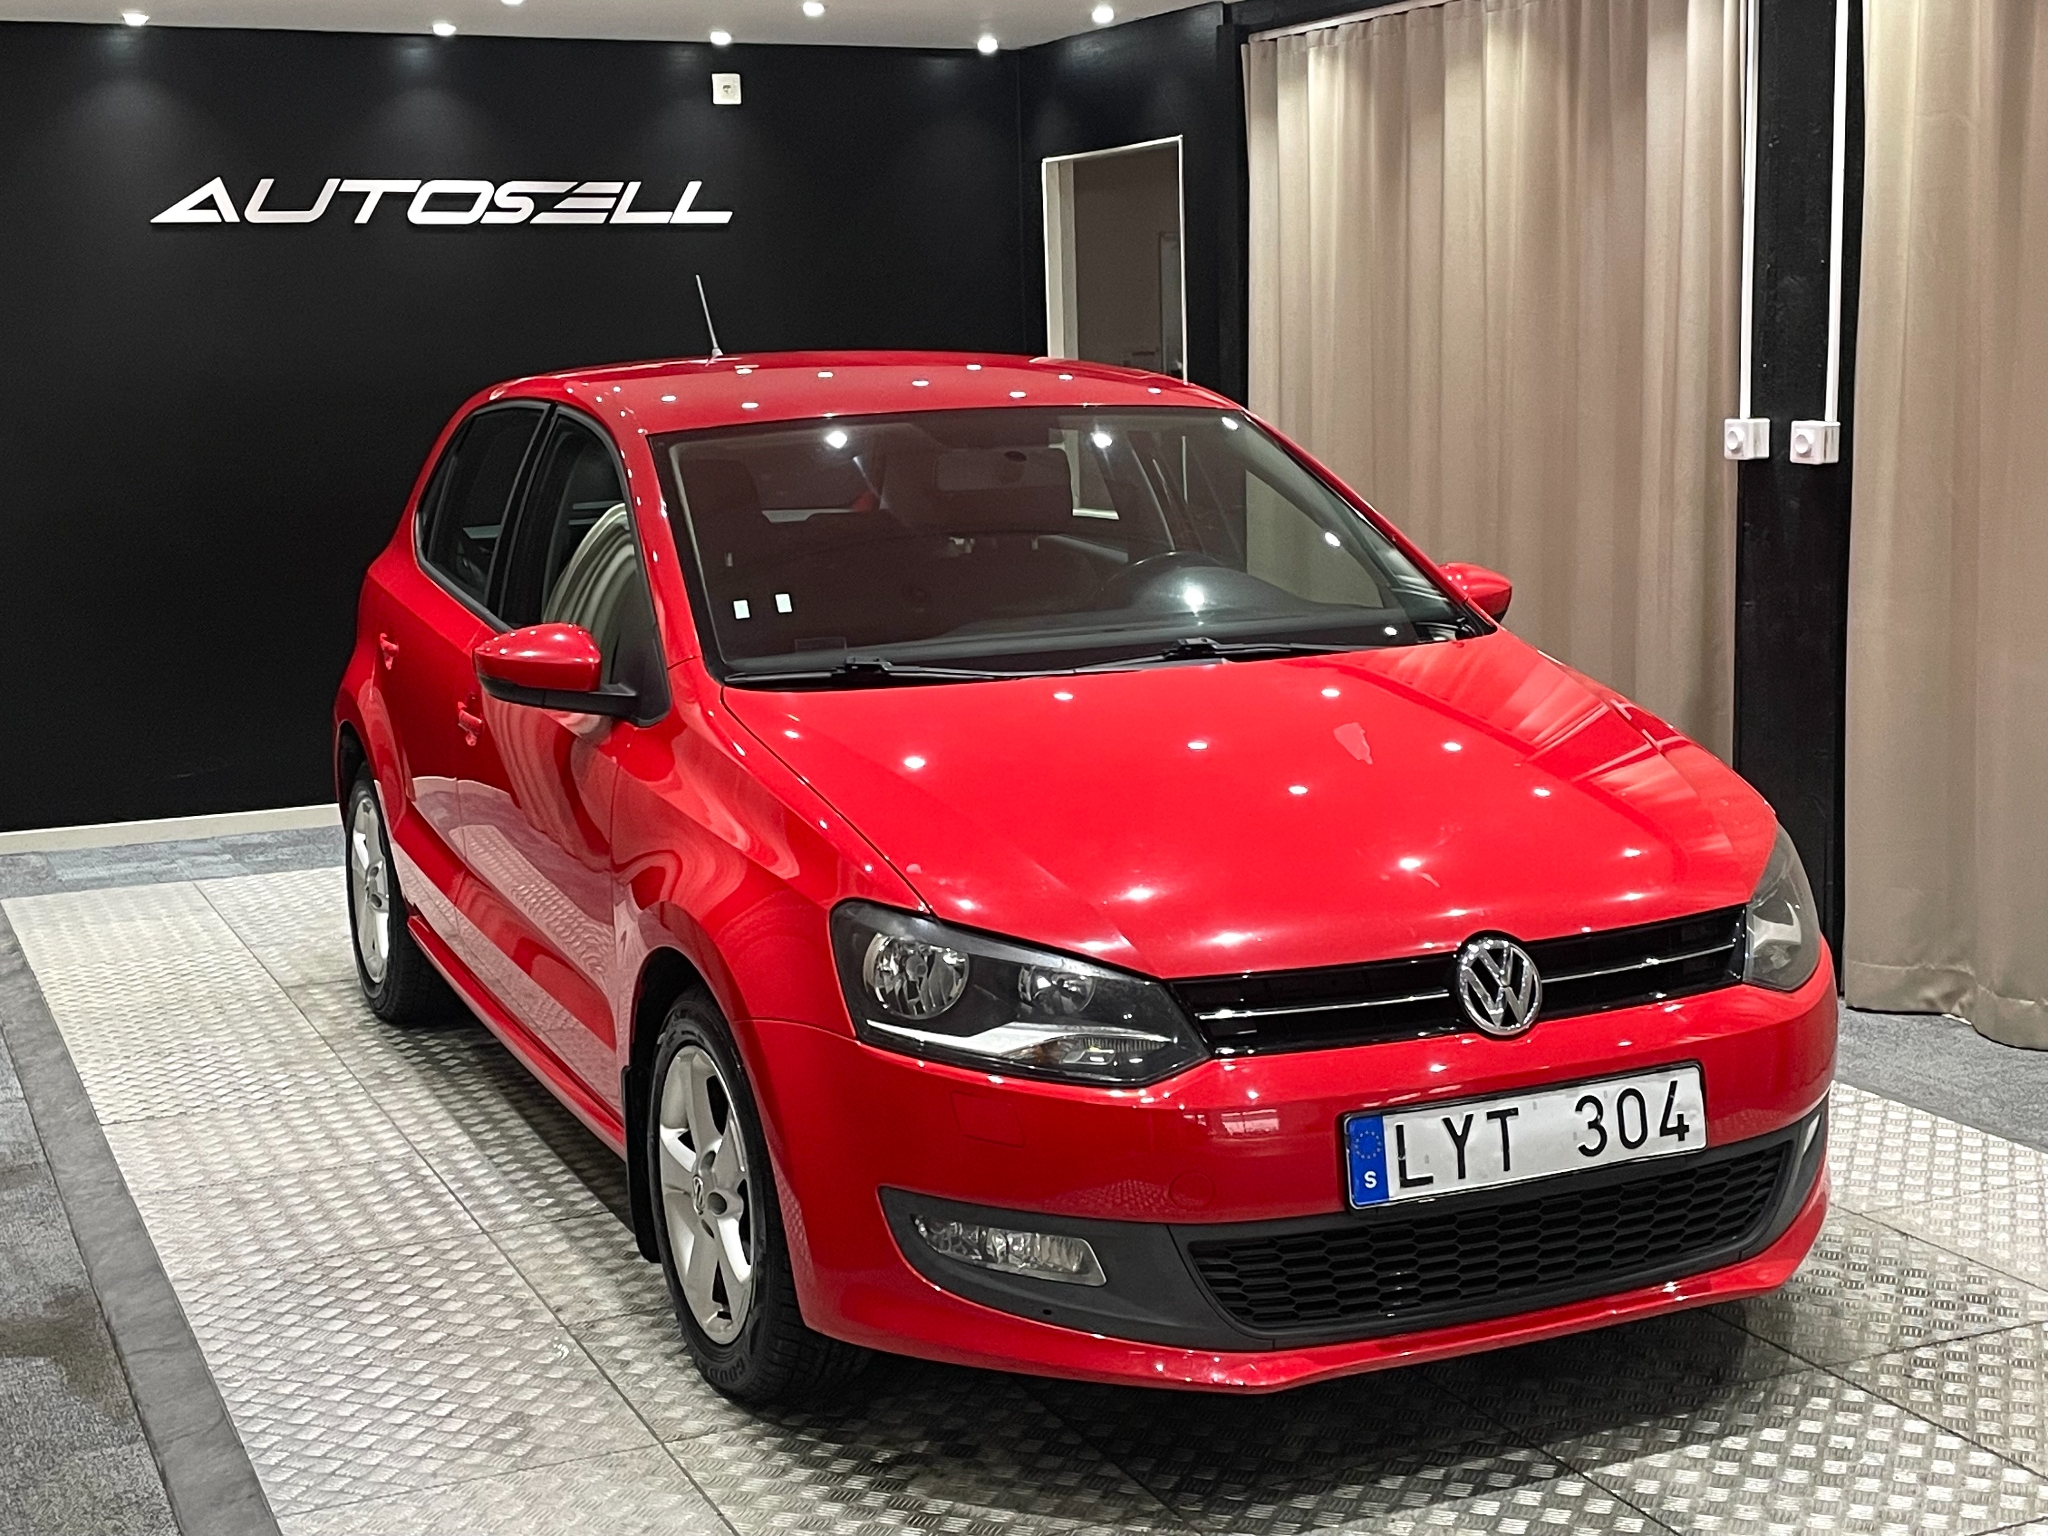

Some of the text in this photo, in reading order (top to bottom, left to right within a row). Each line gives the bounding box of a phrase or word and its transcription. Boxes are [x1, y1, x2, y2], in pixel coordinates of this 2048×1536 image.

[150, 176, 733, 225] AUTOSELL
[1396, 1080, 1690, 1188] LYT 304
[1364, 1171, 1378, 1189] S
